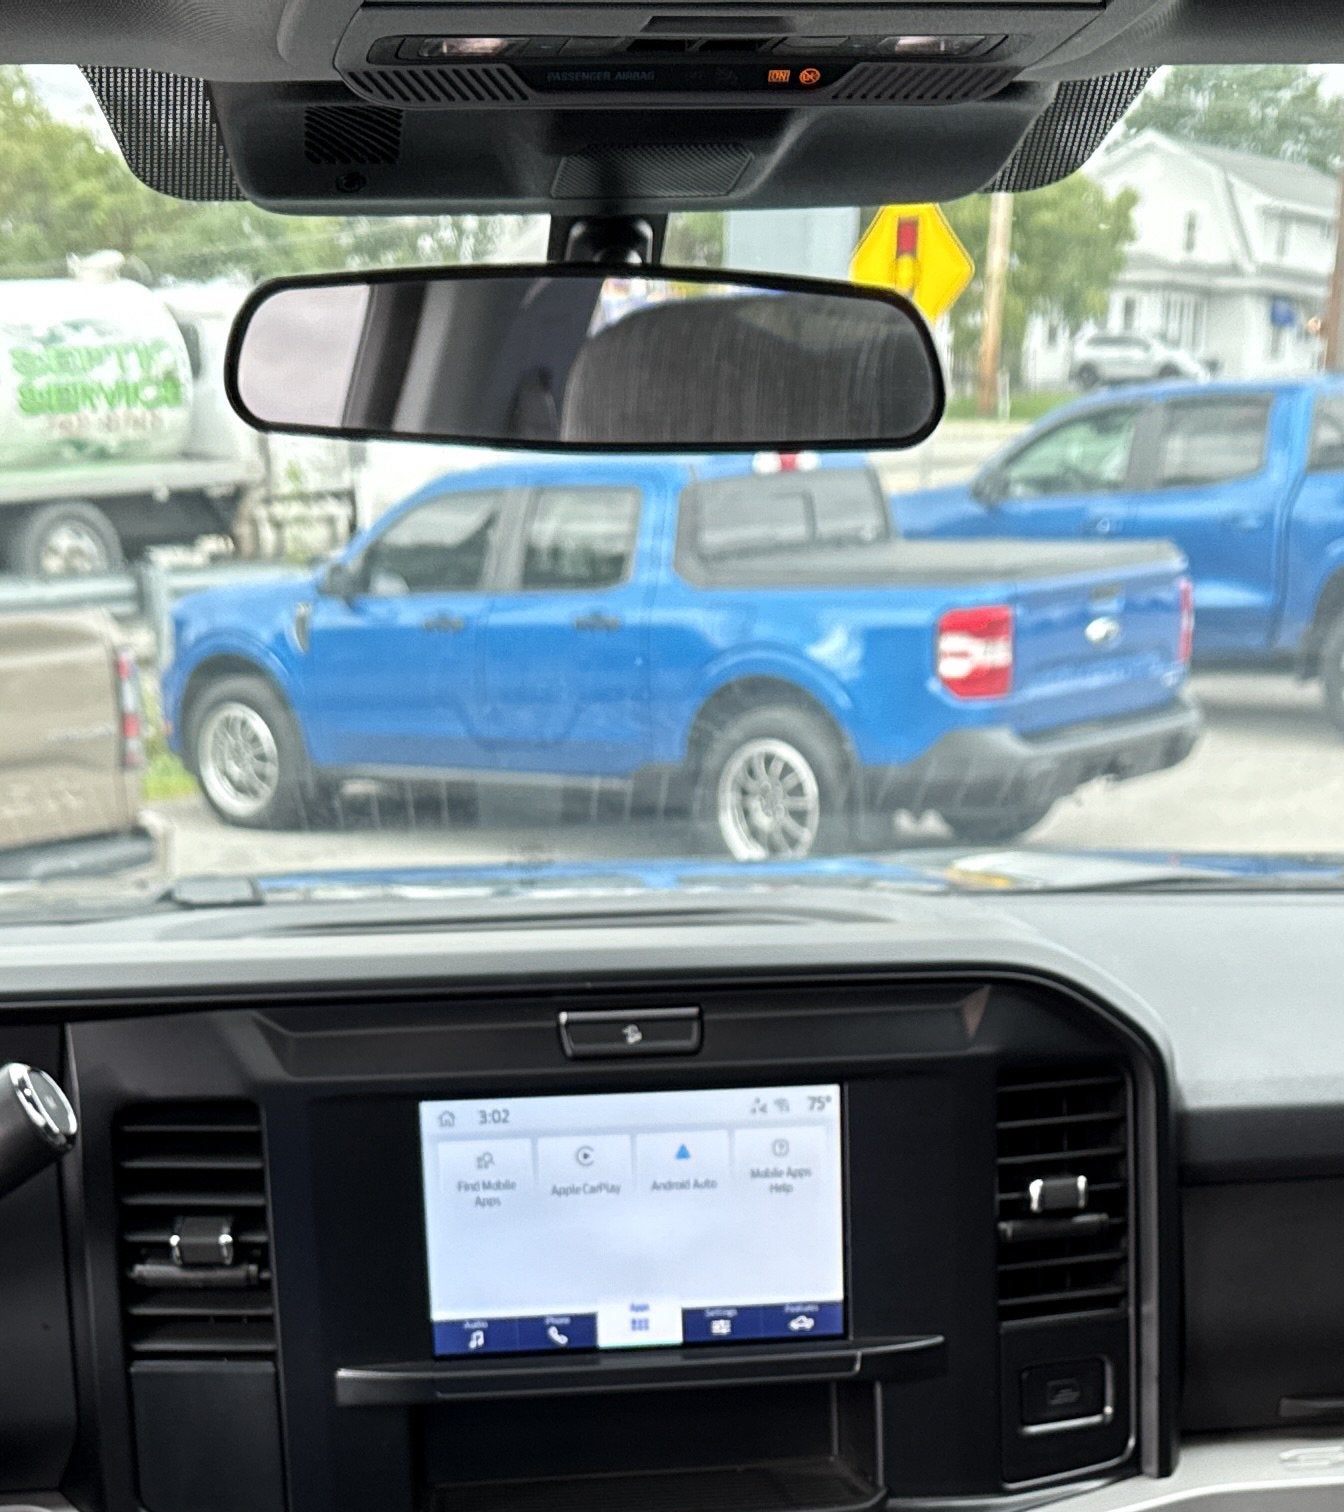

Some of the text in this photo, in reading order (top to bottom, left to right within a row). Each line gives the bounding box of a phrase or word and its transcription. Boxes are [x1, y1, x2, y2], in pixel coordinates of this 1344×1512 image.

[547, 70, 655, 82] PASSENGER AIRBAG
[478, 1108, 511, 1125] 3:02
[750, 1166, 813, 1179] Mobile Apps
[457, 1178, 517, 1192] Find Mobile
[551, 1182, 622, 1197] Apple CarPlay
[650, 1178, 719, 1192] Android Auto
[769, 1183, 794, 1195] Help
[475, 1196, 502, 1208] Apps
